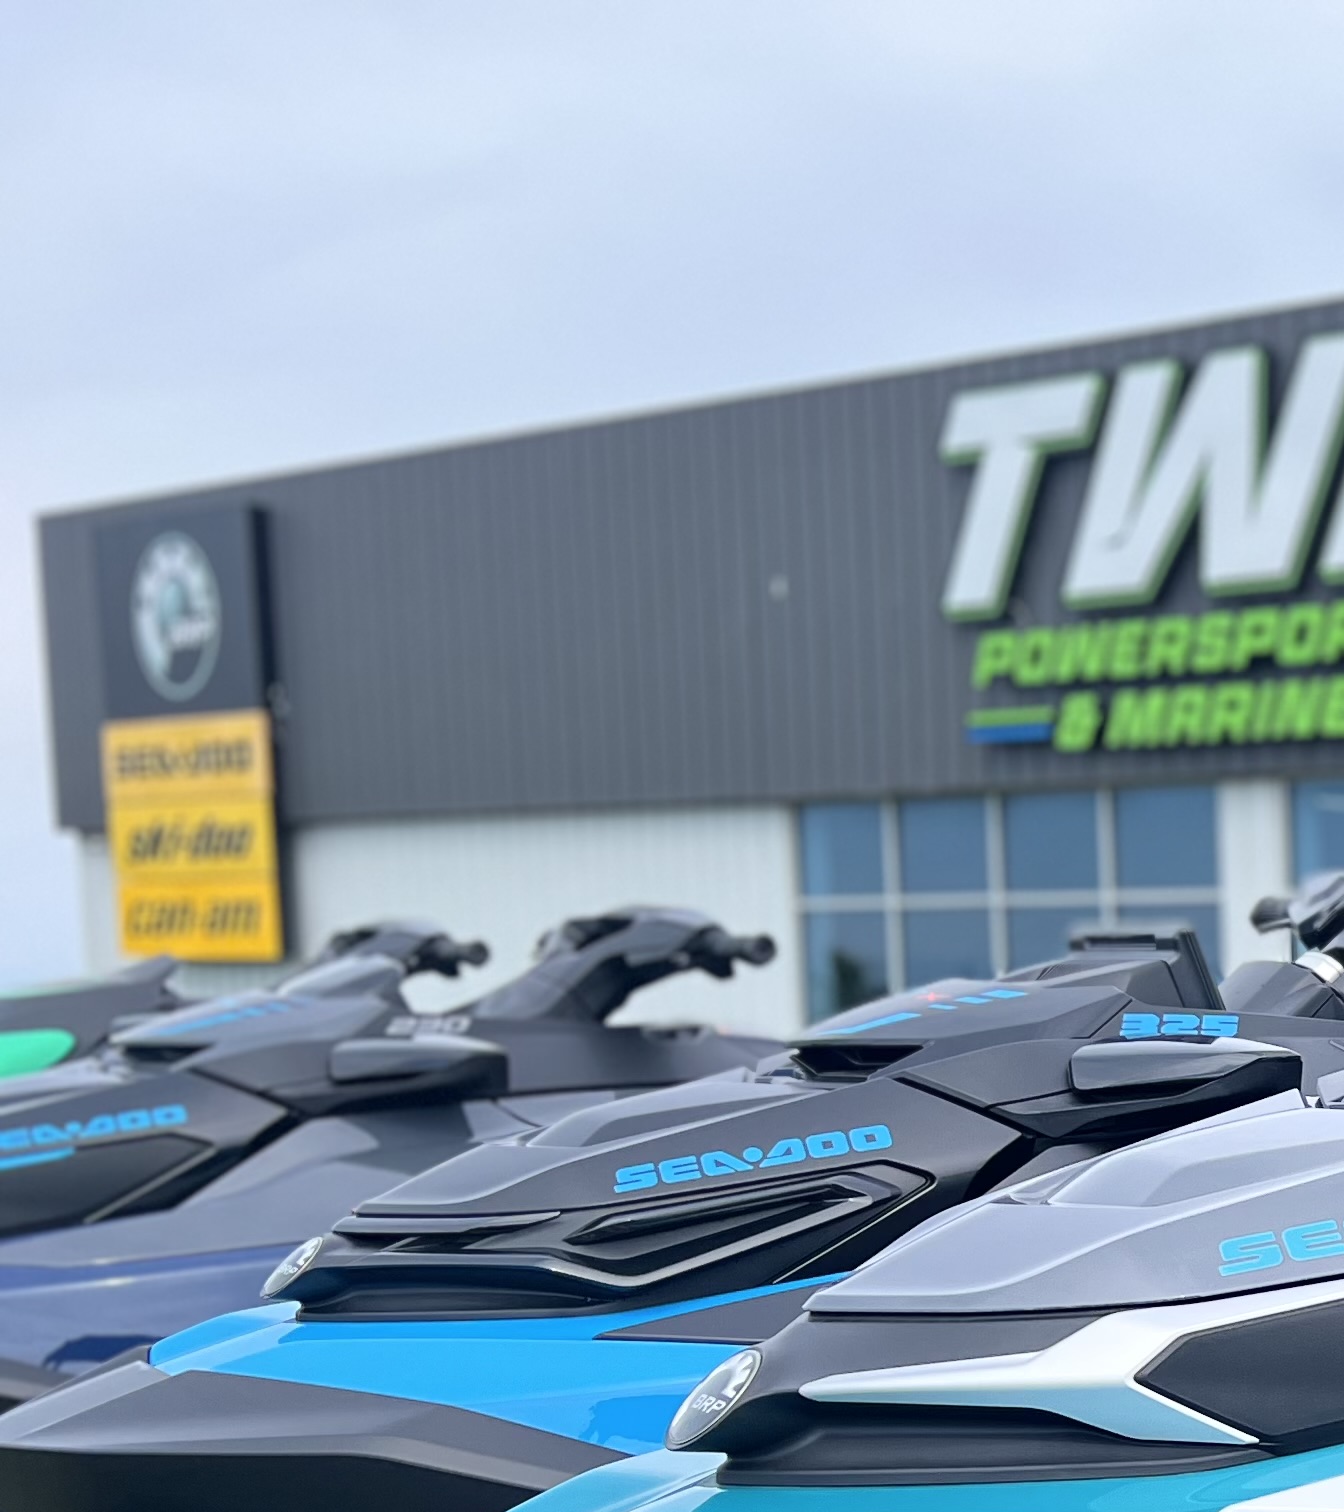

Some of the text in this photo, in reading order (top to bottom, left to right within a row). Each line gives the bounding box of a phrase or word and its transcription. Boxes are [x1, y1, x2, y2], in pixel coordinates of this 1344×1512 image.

[1053, 691, 1102, 752] &
[1120, 1012, 1239, 1038] 325
[692, 1394, 726, 1413] BRP
